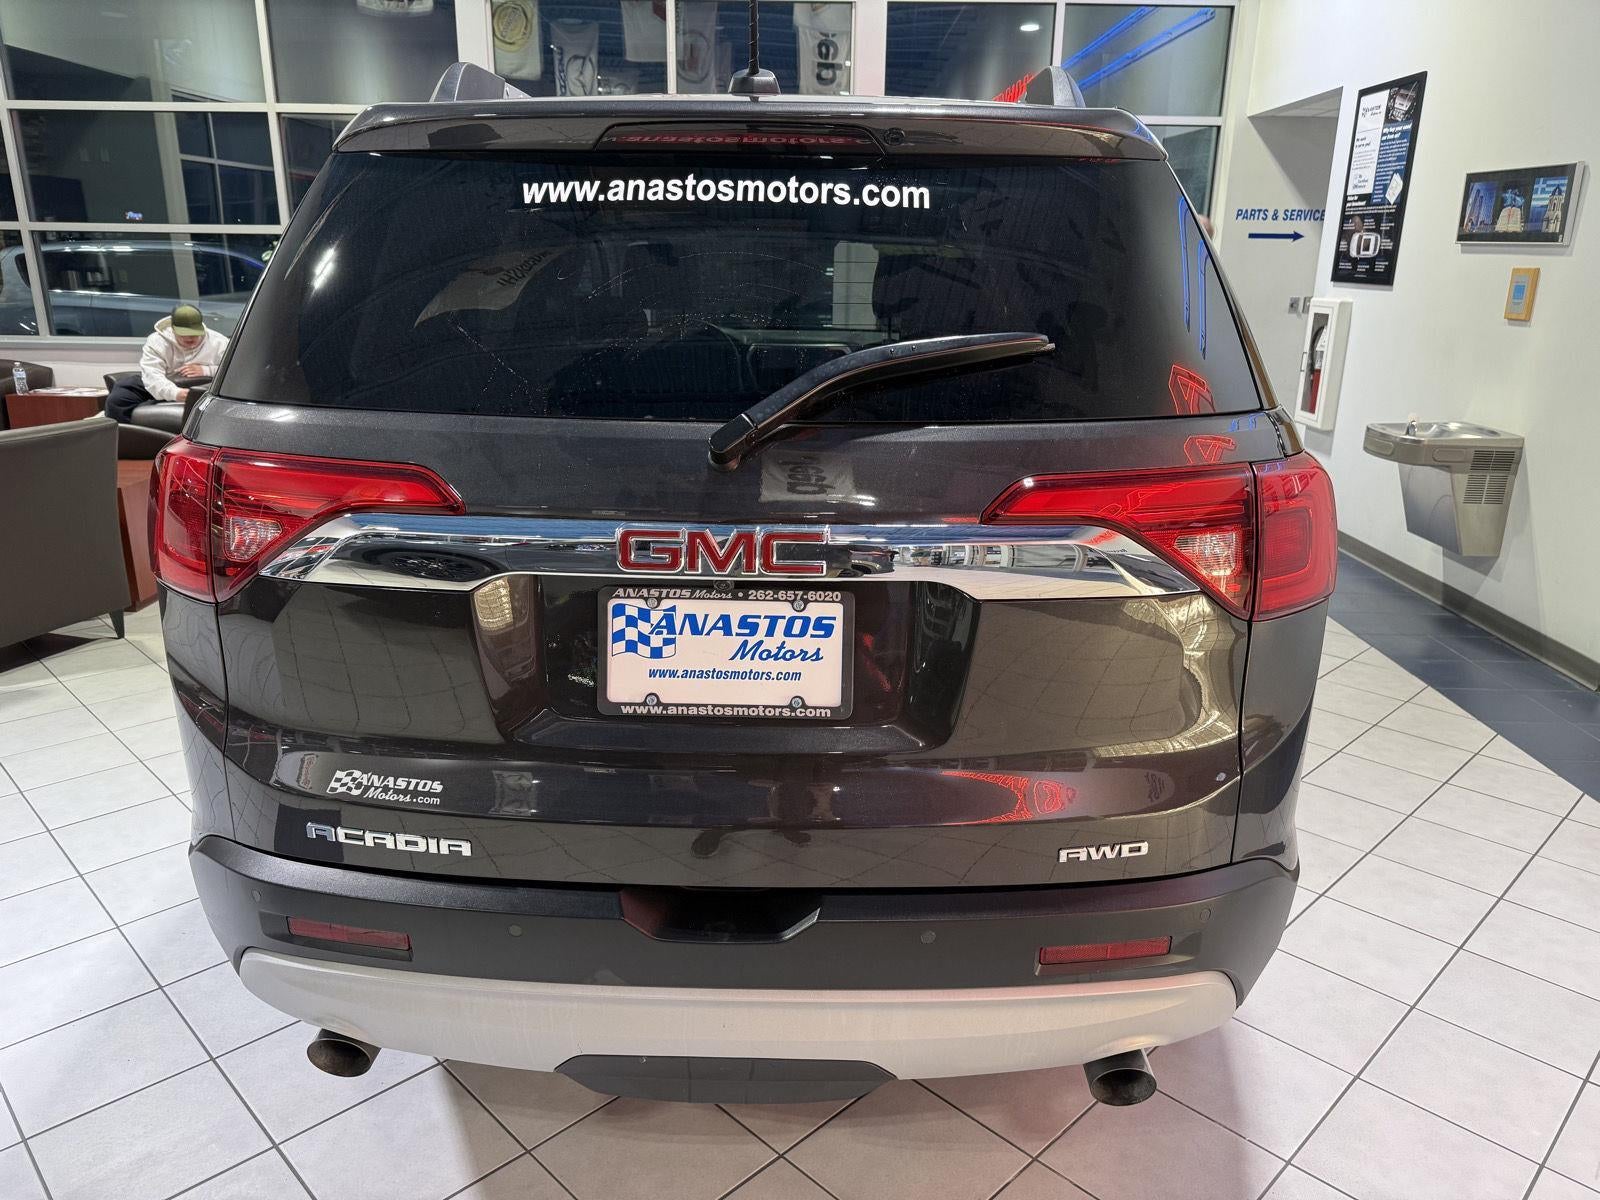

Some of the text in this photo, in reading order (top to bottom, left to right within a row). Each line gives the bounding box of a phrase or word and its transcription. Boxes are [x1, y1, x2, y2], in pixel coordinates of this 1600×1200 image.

[523, 173, 930, 209] www.anastosmotors.com
[1235, 209, 1325, 222] PARTS & SERVICE
[616, 528, 827, 576] GMC
[612, 588, 841, 602] ANASTOS Motors 262-657-6020
[649, 612, 836, 639] ANASTOS
[729, 639, 823, 662] Motors
[648, 667, 801, 681] www.anastosmotors.com
[620, 703, 831, 718] www.anastosmotors.com
[357, 773, 443, 793] ANASTOS
[306, 821, 472, 857] ACADIA
[1058, 840, 1149, 863] AWD
